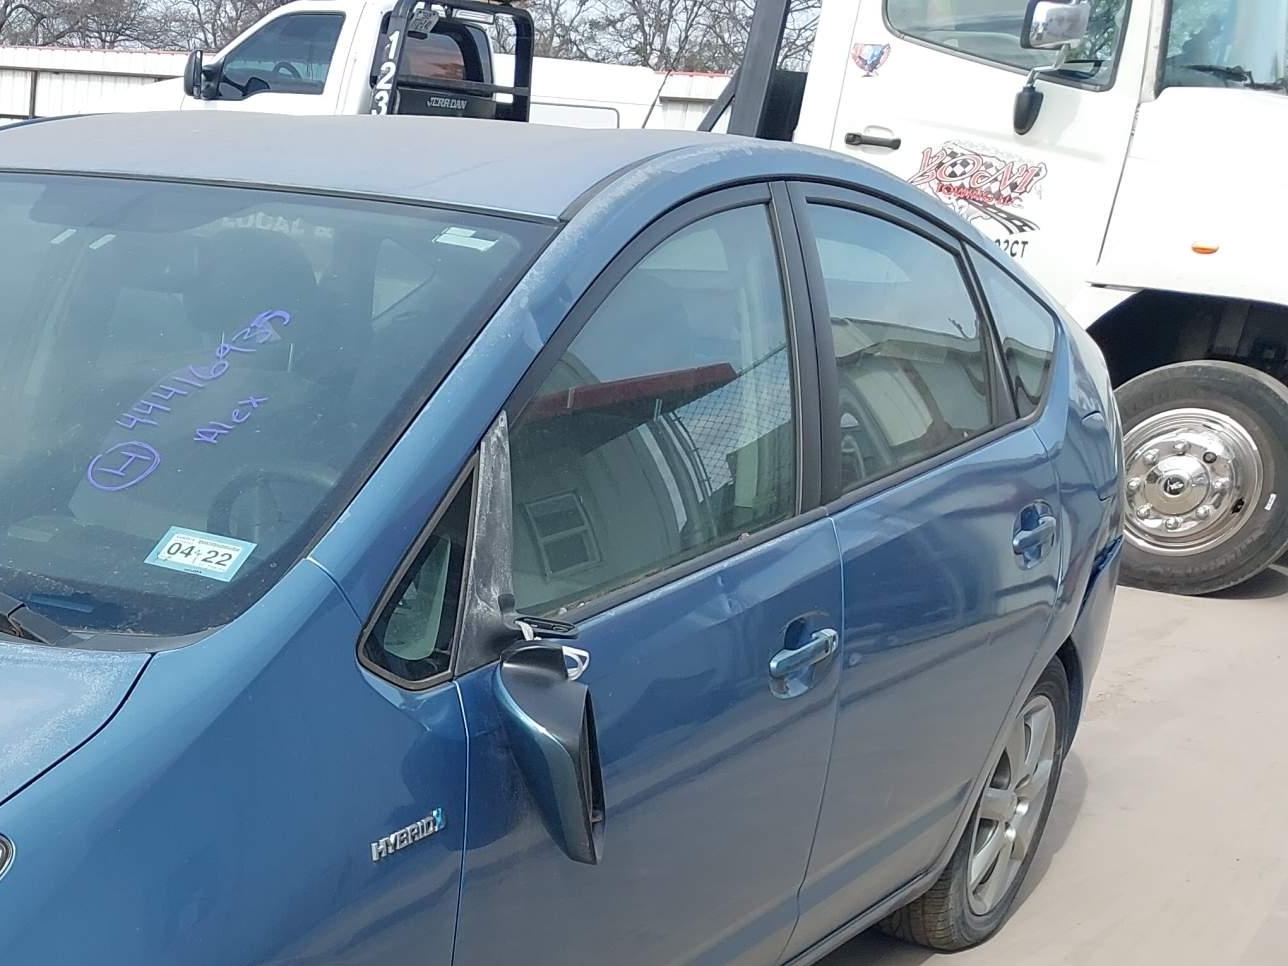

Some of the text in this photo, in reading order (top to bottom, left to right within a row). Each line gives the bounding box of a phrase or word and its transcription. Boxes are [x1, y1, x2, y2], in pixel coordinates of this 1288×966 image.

[114, 308, 291, 430] 44416935
[192, 396, 269, 443] Alex
[166, 542, 195, 558] 04
[201, 550, 233, 567] 22
